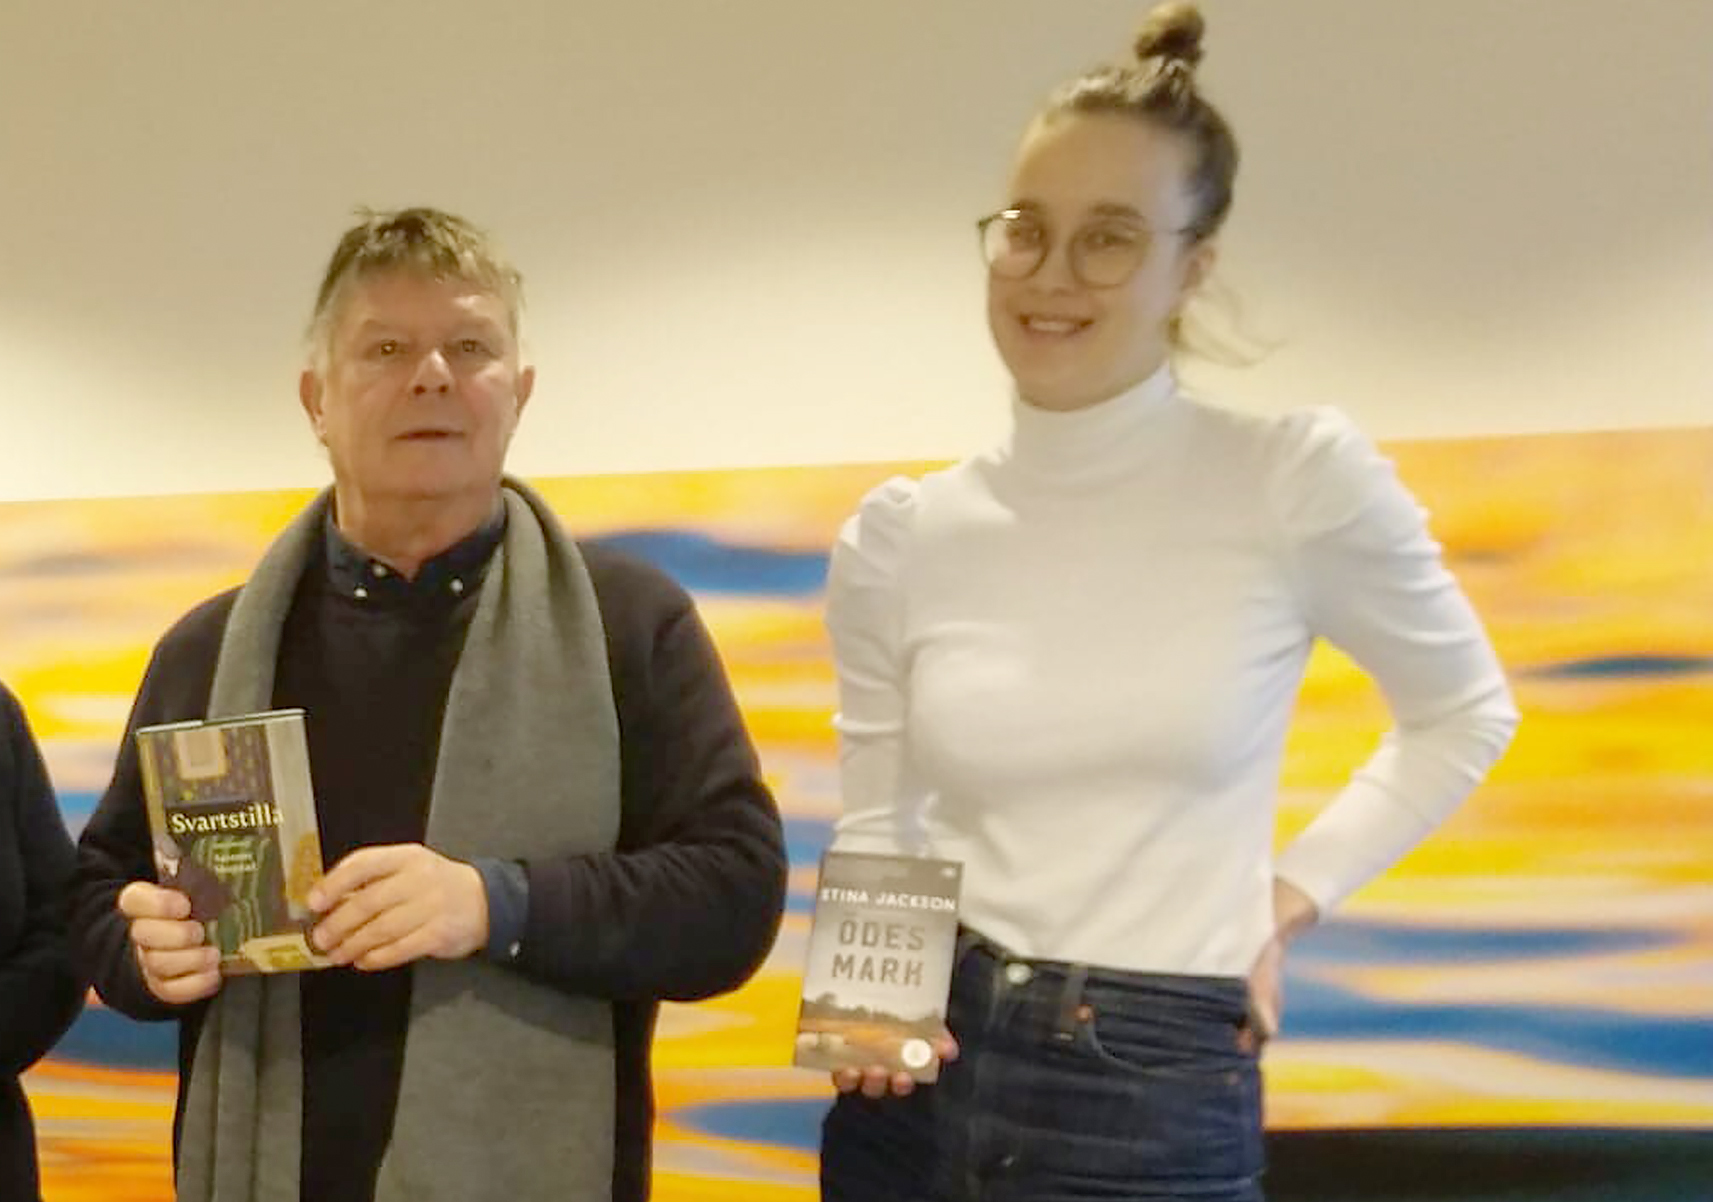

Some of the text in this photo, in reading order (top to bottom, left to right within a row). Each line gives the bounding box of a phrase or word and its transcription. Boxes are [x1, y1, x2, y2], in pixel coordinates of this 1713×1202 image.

[171, 802, 284, 833] Svartstilla
[820, 888, 956, 911] STINA JACKSON
